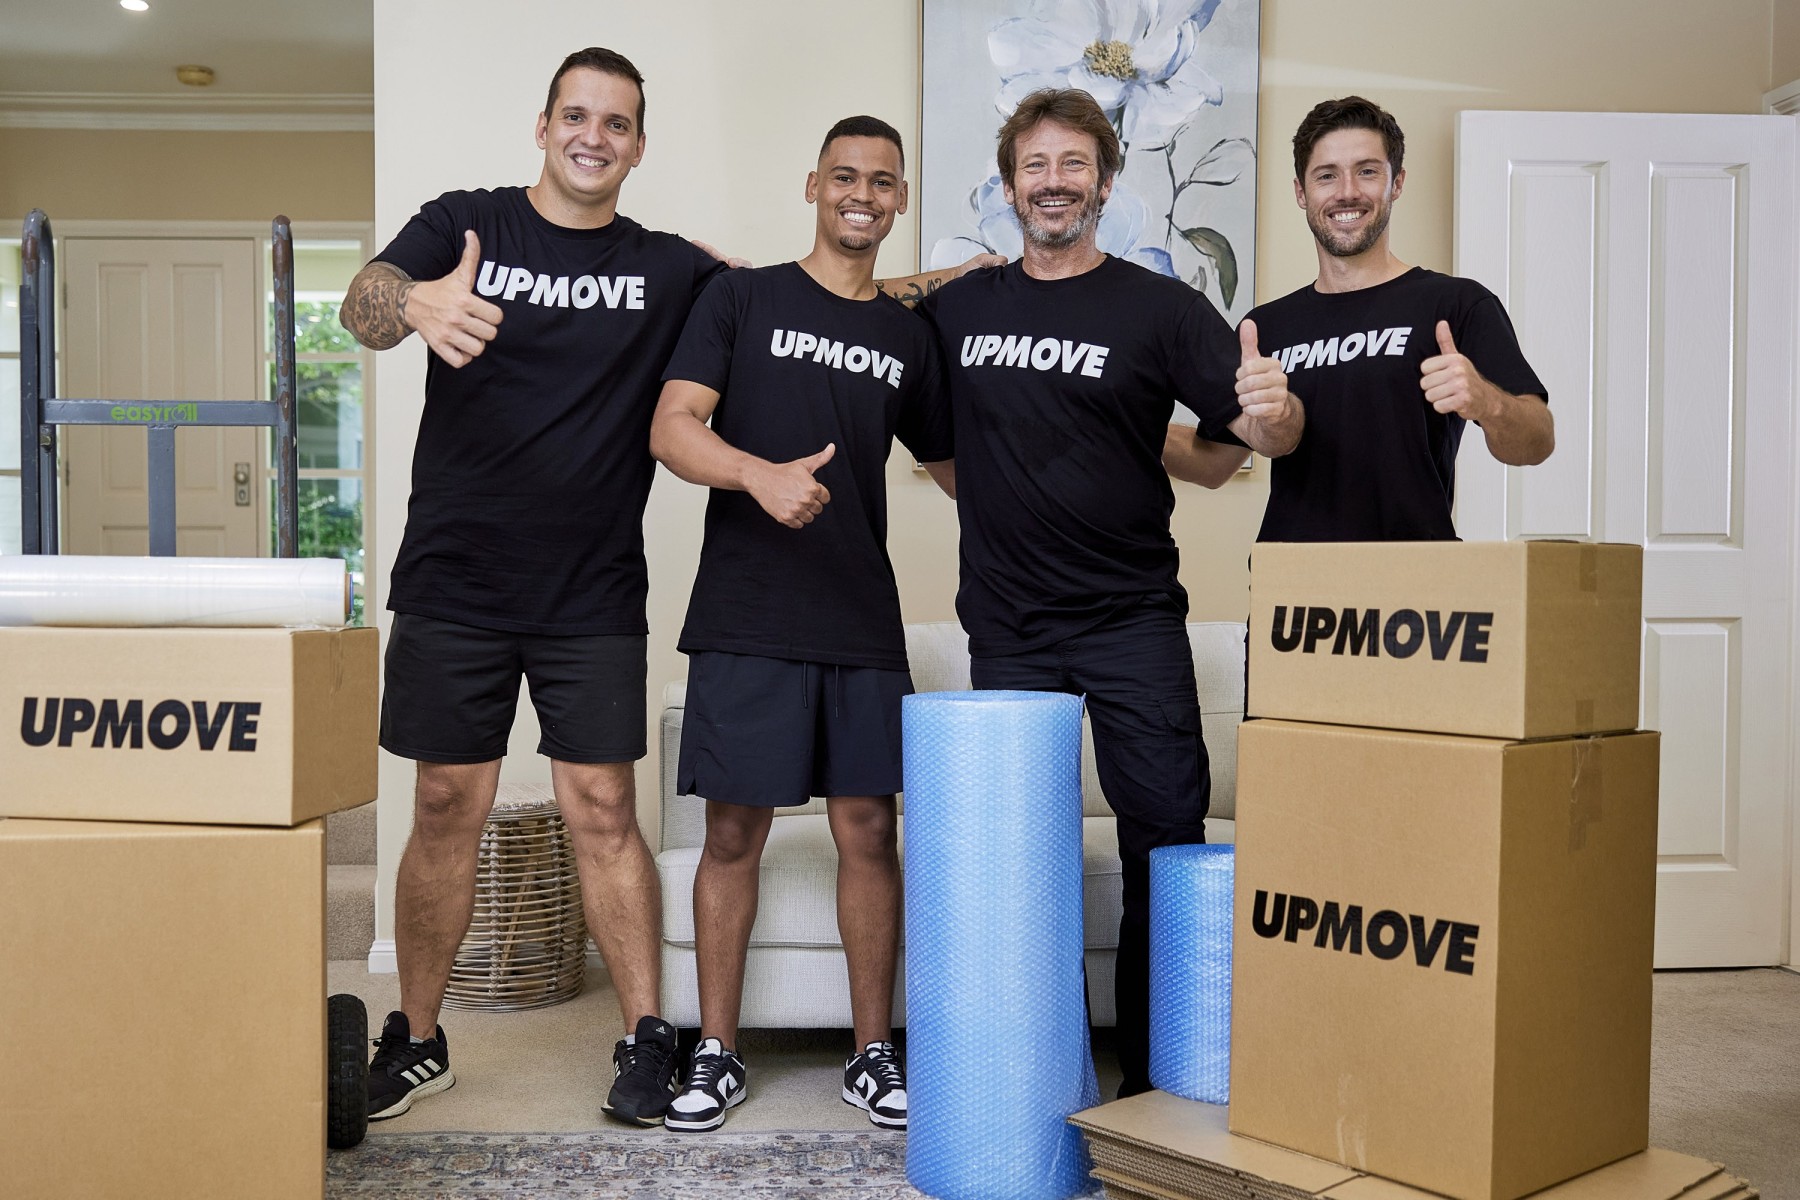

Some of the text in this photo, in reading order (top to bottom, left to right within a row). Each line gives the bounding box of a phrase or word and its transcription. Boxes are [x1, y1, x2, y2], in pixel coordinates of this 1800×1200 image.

[477, 260, 645, 310] UPMOVE
[771, 328, 904, 389] UPMOVE
[960, 335, 1110, 379] UPMOVE
[111, 403, 198, 422] easyroll
[1271, 605, 1494, 663] UPMOVE
[20, 697, 262, 752] UPMOVE
[1252, 889, 1480, 976] UPMOVE
